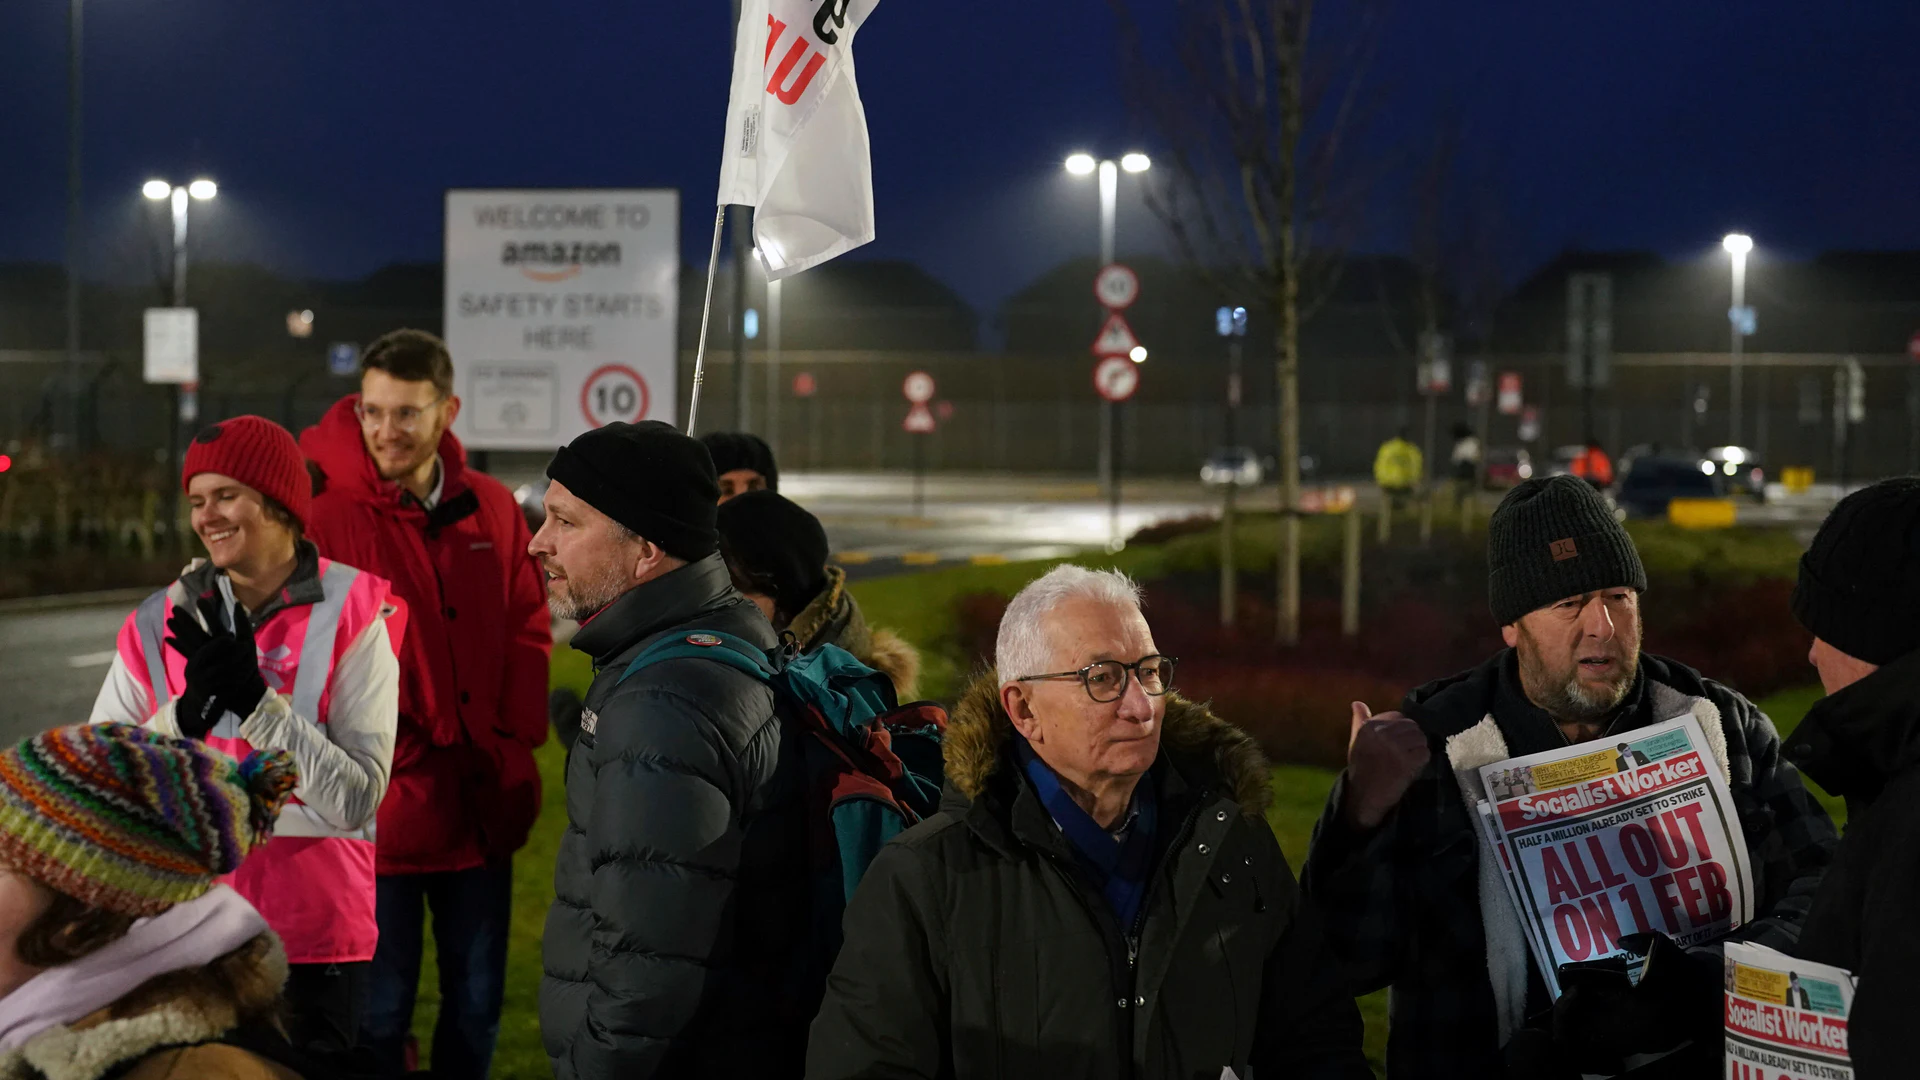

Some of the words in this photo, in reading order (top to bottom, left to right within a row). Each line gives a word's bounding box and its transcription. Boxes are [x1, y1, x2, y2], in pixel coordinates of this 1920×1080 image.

[474, 204, 606, 229] WELCOME
[614, 204, 650, 230] TO
[502, 242, 621, 265] amazon
[459, 293, 558, 318] SAFETY
[564, 294, 664, 319] STARTS
[523, 325, 593, 349] HERE
[596, 383, 636, 414] 10
[1535, 766, 1549, 775] WHY
[1549, 760, 1579, 772] STRIKING
[1580, 753, 1608, 764] NURSES
[1537, 769, 1562, 781] TERRIFY
[1563, 766, 1576, 776] THE
[1576, 762, 1601, 774] TORIES
[1518, 780, 1618, 820] Socialist
[1612, 757, 1699, 796] Worker
[1518, 836, 1543, 850] HALF
[1544, 833, 1552, 843] A
[1551, 824, 1591, 841] MILLION
[1592, 812, 1635, 832] ALREADY
[1636, 804, 1655, 818] SET
[1657, 798, 1670, 809] TO
[1670, 786, 1706, 806] STRIKE
[1541, 835, 1627, 905] ALL
[1618, 801, 1712, 877] OUT
[1553, 892, 1622, 961] ON
[1618, 883, 1656, 934] 1
[1651, 862, 1732, 935] FEB
[1693, 932, 1703, 942] OF
[1728, 995, 1783, 1038] Socialist
[1738, 1045, 1760, 1063] MILLION
[1760, 1051, 1791, 1070] ALREADY
[1792, 1060, 1807, 1074] SET
[1807, 1062, 1819, 1076] TO
